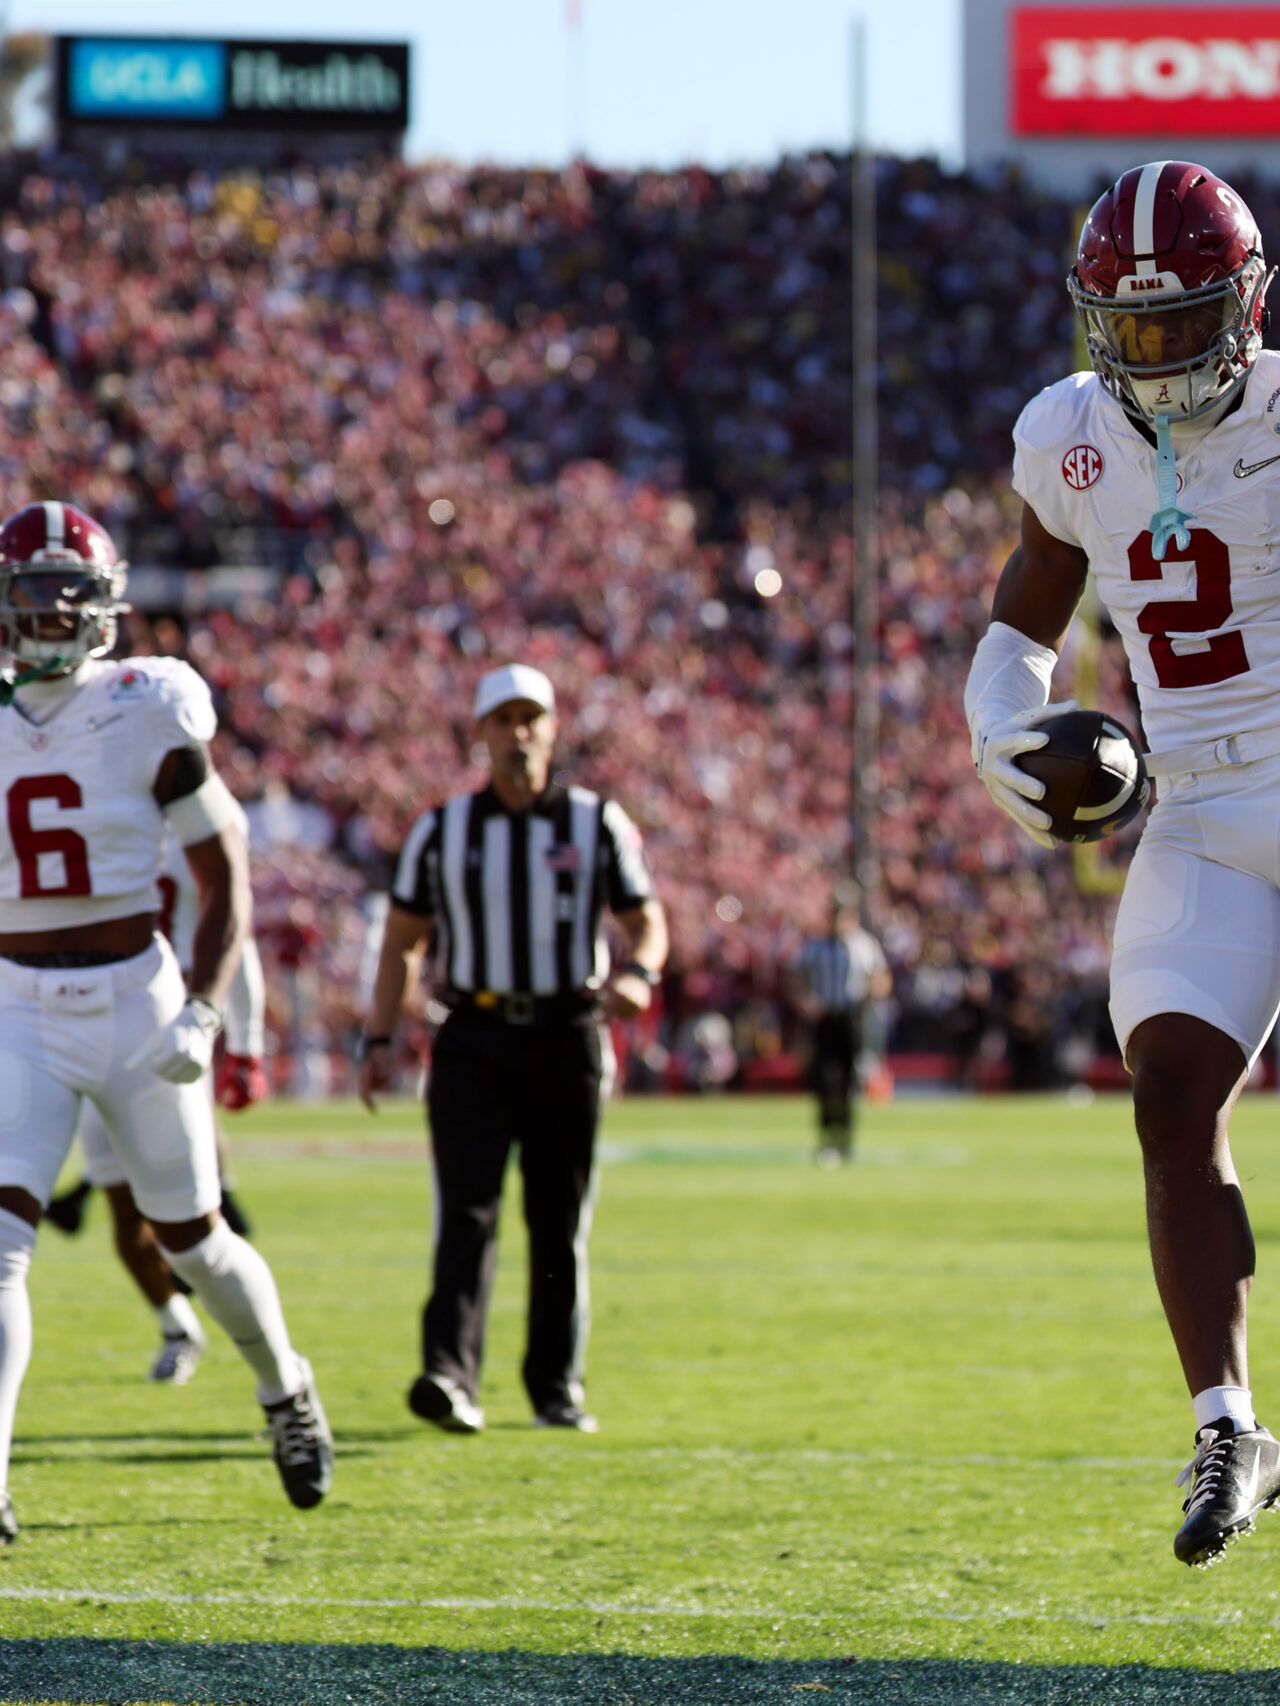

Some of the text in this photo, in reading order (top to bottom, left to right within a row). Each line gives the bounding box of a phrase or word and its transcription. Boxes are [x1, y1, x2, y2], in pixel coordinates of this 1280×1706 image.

[89, 49, 400, 113] UCLA Health
[1130, 277, 1164, 291] BAMA
[1063, 447, 1102, 489] SEC
[1127, 528, 1251, 689] 2
[7, 772, 92, 899] 6
